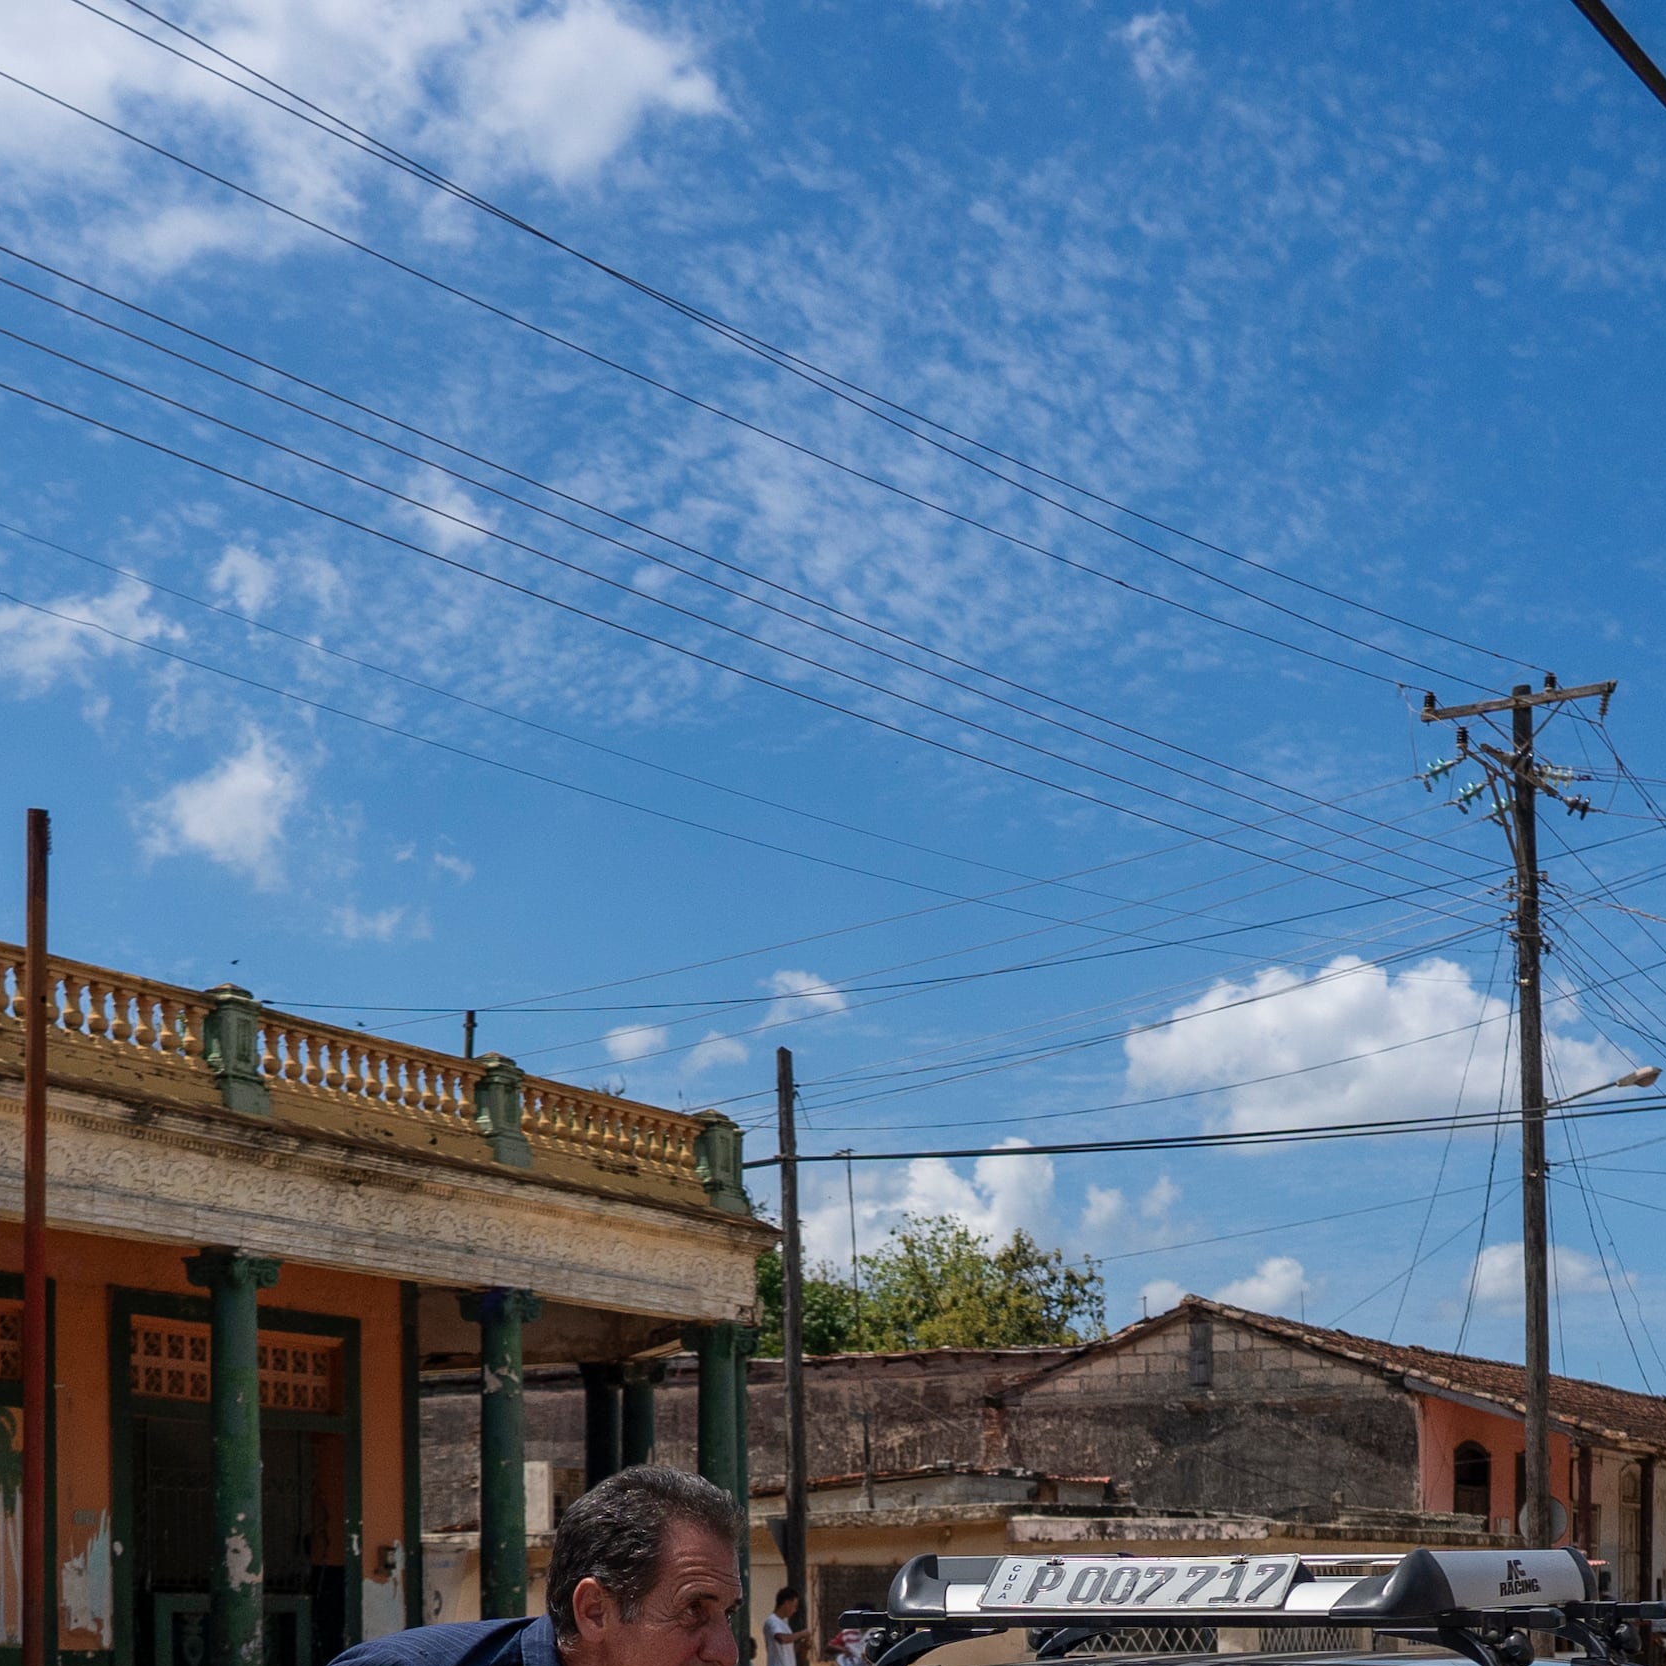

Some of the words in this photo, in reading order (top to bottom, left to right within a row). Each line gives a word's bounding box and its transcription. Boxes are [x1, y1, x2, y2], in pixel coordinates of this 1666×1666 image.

[996, 1564, 1023, 1601] CUBA
[1506, 1559, 1526, 1580] AC
[1022, 1565, 1066, 1604] P
[1499, 1578, 1541, 1597] RACING
